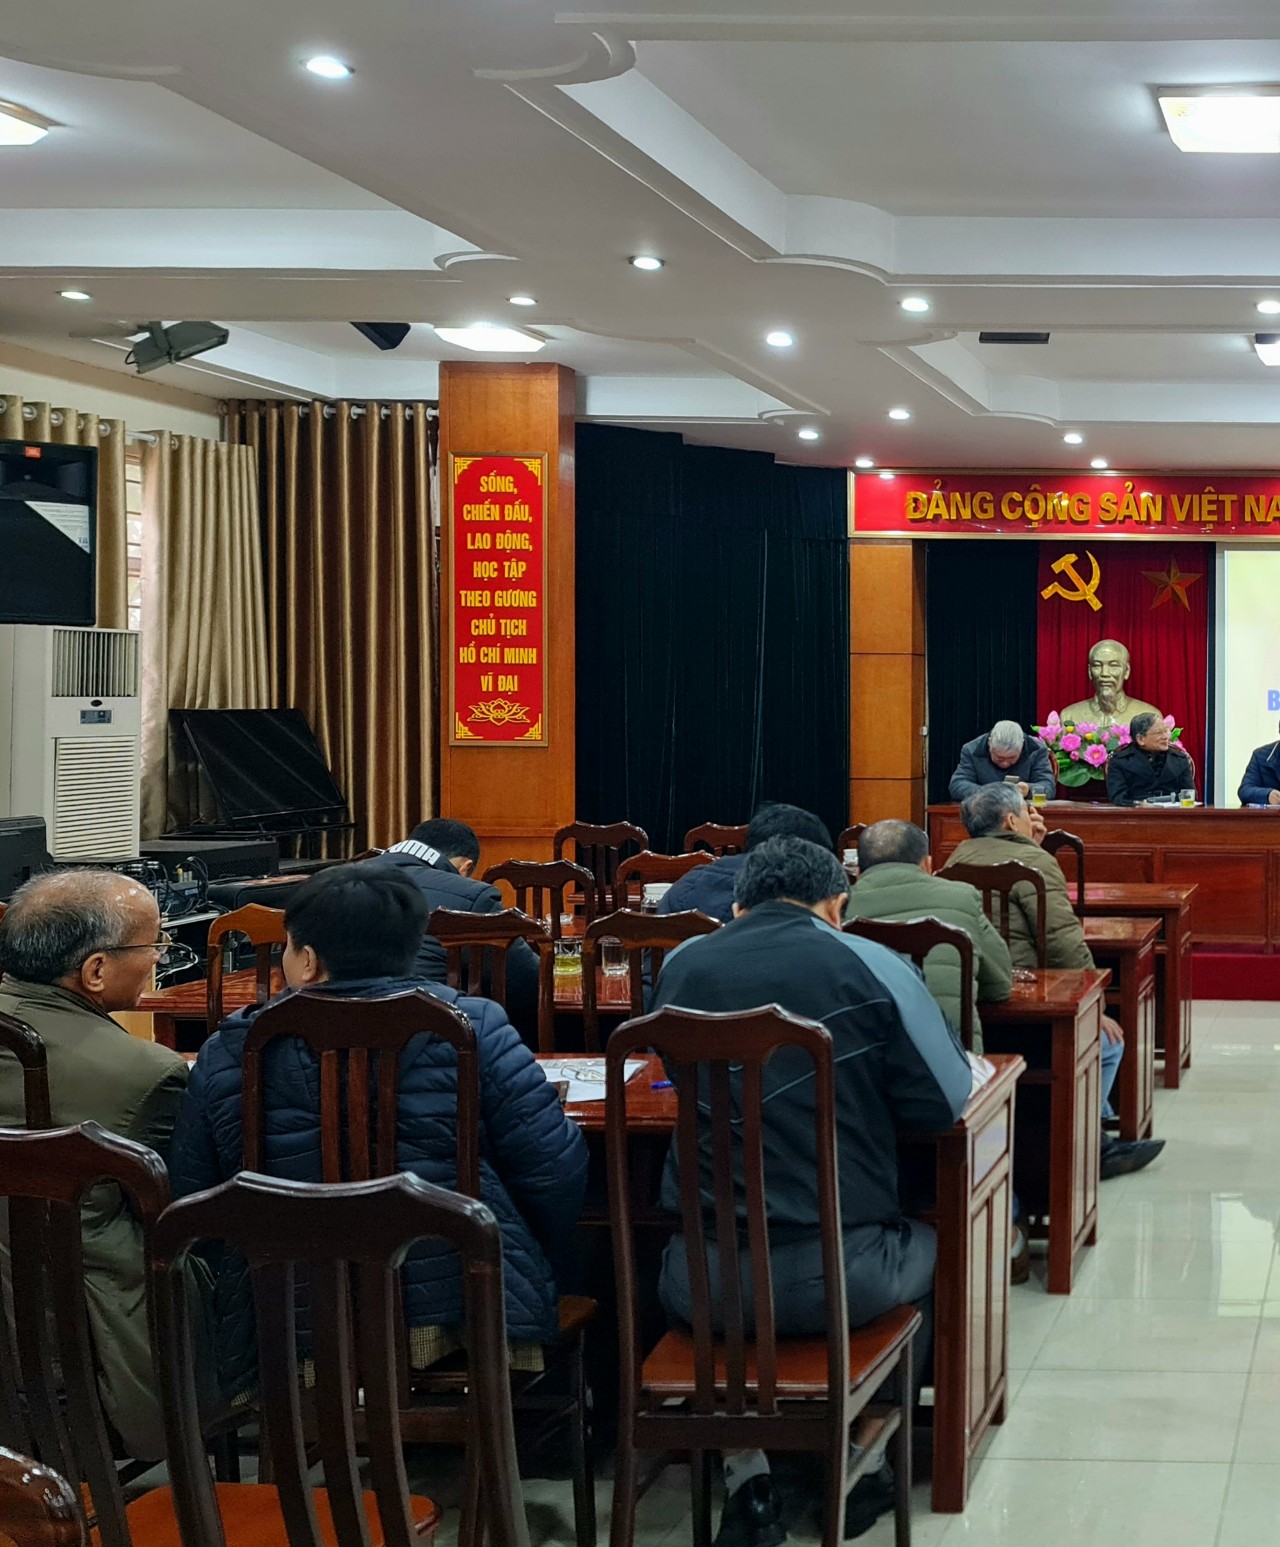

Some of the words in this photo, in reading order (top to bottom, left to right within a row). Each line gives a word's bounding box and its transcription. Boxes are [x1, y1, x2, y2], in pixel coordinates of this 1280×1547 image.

[480, 470, 517, 494] SỐNG,
[463, 500, 499, 520] CHIẾN
[504, 500, 532, 523] ĐẤU,
[906, 479, 994, 520] ĐẢNG
[1001, 484, 1090, 528] CỘNG
[1100, 481, 1163, 523] SẢN
[1171, 486, 1236, 529] VIỆT
[467, 533, 490, 549] LAO
[496, 530, 532, 552] ĐỘNG,
[474, 562, 498, 580] HỌC
[504, 558, 526, 580] TẬP
[460, 590, 491, 606] THEO
[495, 590, 537, 607] GƯƠNG
[471, 613, 496, 636] CHỦ
[500, 619, 526, 638] TỊCH
[460, 640, 476, 664] HỒ
[480, 643, 500, 664] CHÍ
[504, 648, 537, 664] MINH
[481, 672, 493, 692] VĨ
[498, 676, 518, 695] ĐẠI
[387, 840, 440, 865] UMA
